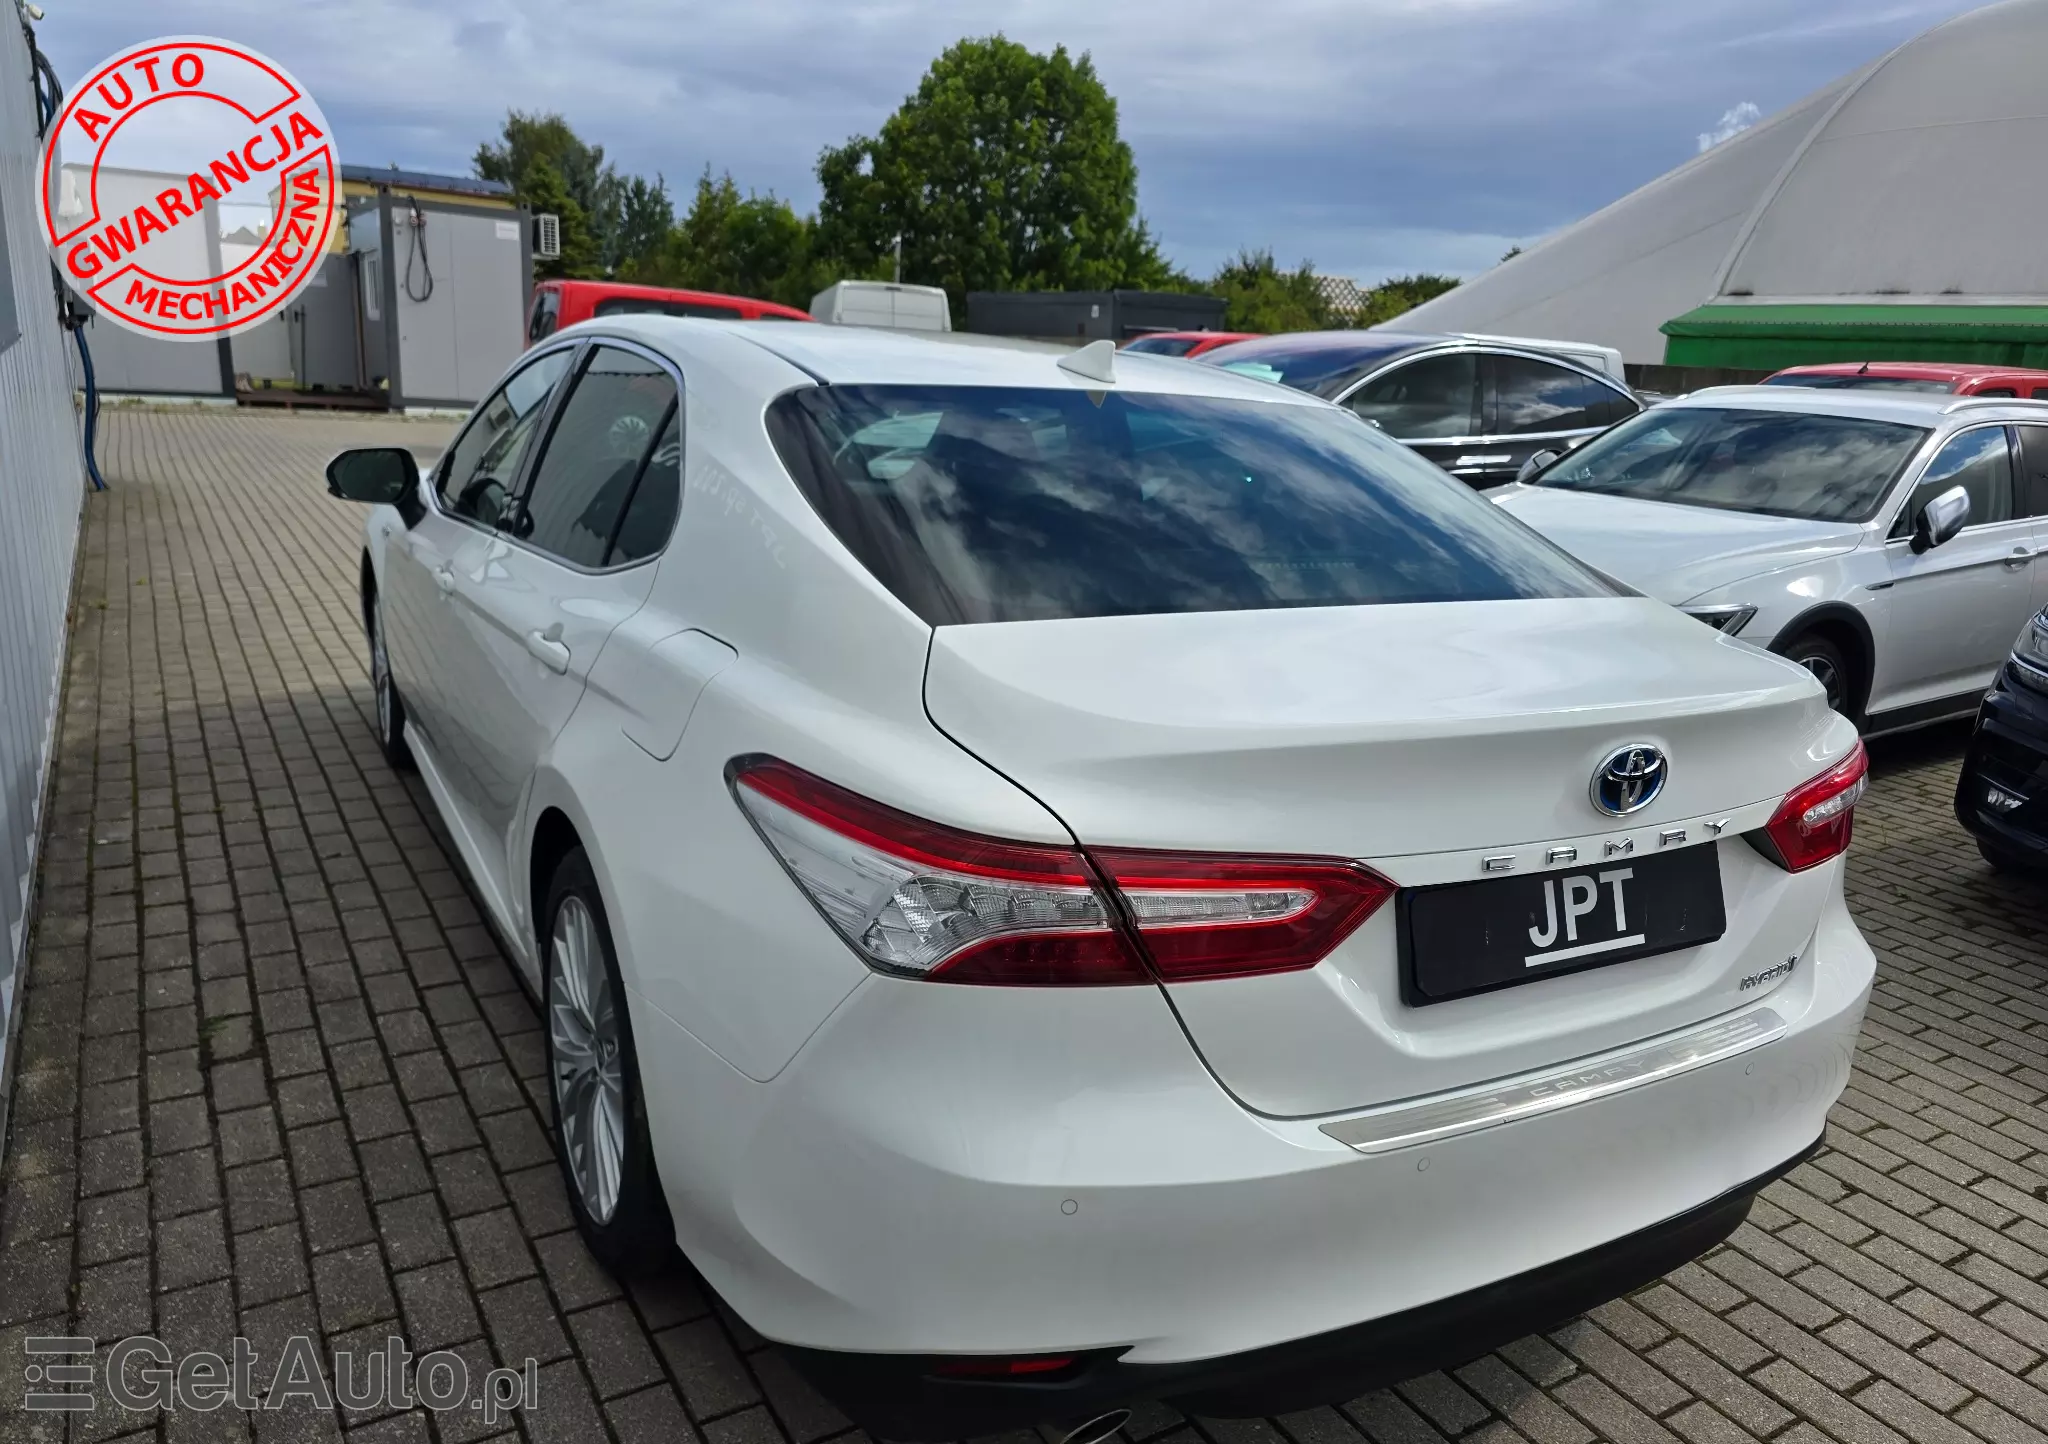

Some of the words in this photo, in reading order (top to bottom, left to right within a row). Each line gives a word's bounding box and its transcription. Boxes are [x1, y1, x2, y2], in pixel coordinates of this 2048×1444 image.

[1481, 817, 1732, 872] CAMRY
[1528, 867, 1634, 948] JPT
[1529, 1059, 1646, 1098] CAMRY
